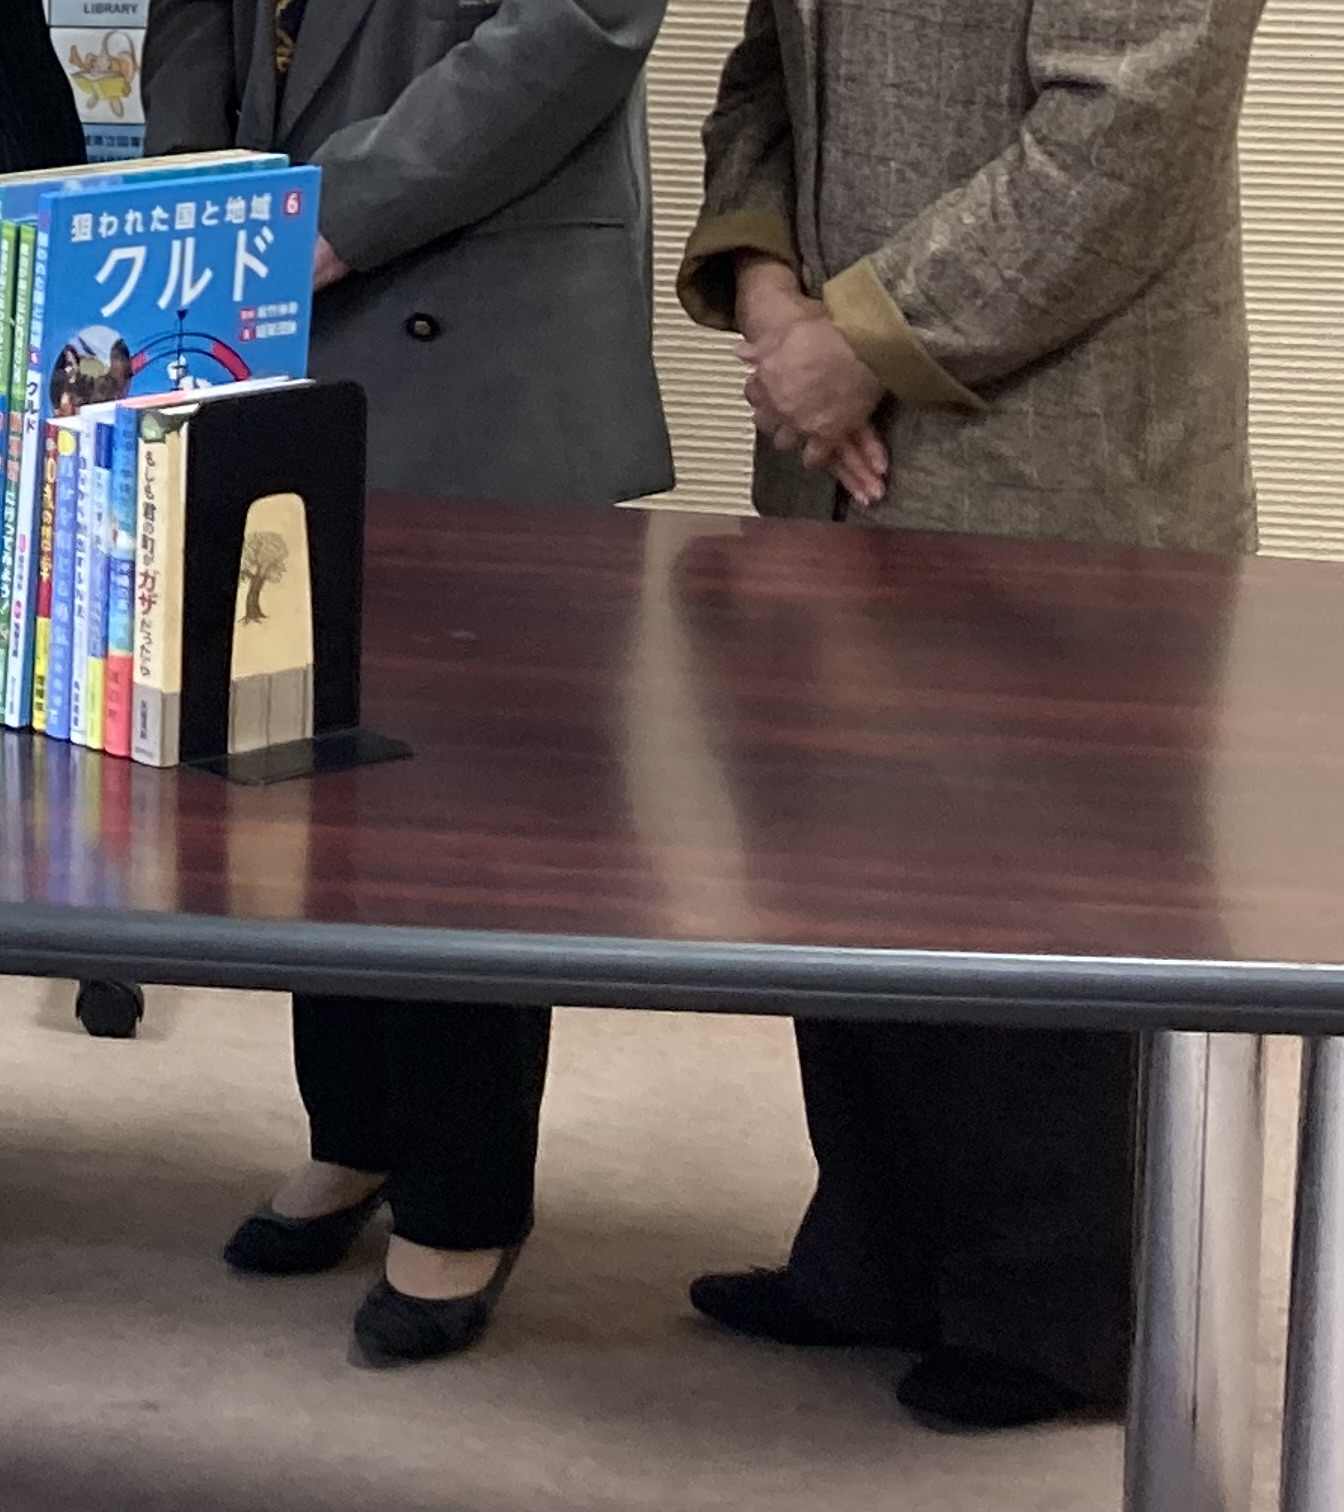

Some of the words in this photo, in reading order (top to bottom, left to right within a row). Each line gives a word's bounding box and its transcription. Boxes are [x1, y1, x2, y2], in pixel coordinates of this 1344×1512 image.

[84, 2, 138, 14] LIBRARY
[71, 193, 272, 243] 狙われた国と地域
[286, 192, 299, 212] 6
[95, 226, 275, 317] クルド
[25, 381, 39, 433] クルド
